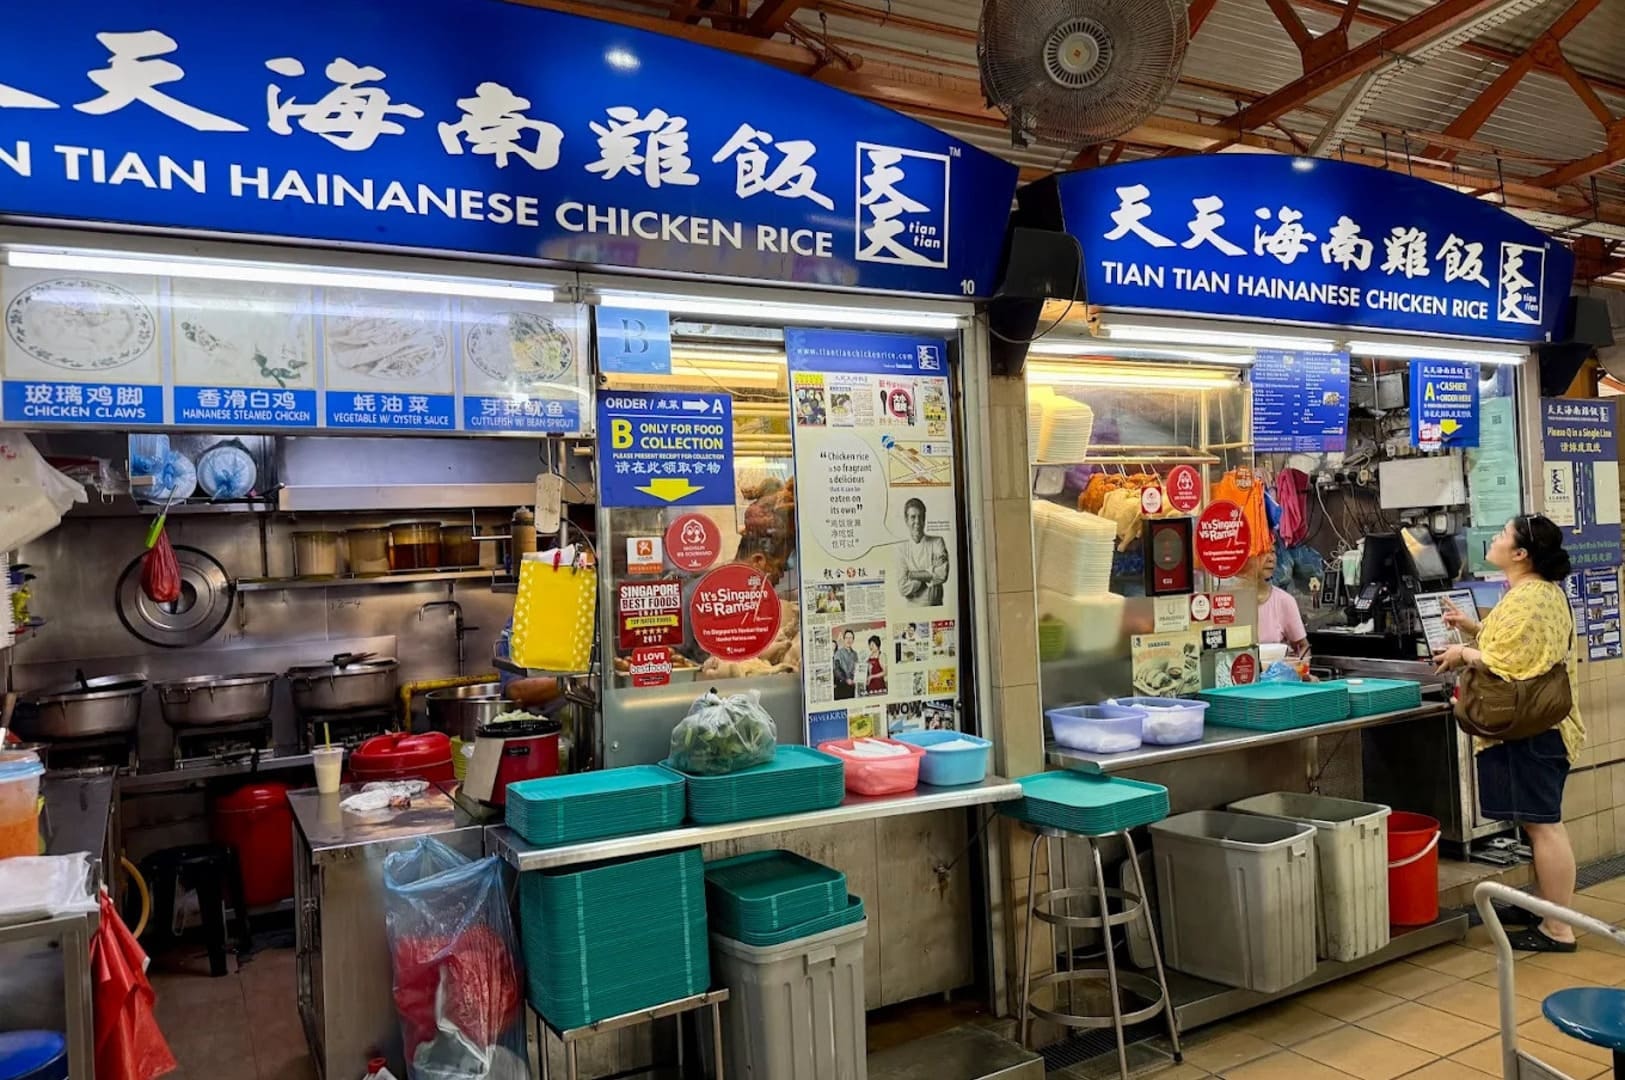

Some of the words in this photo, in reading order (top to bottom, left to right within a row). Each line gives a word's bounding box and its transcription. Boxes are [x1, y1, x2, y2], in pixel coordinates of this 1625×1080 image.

[54, 145, 206, 194] TIAN
[230, 164, 539, 227] HAINANESE
[555, 201, 743, 249] CHICKEN
[757, 224, 833, 257] RICE
[909, 221, 936, 235] tian
[1102, 183, 1491, 287] 天天海南雞飯
[913, 235, 941, 249] tian
[960, 279, 975, 295] 10
[1102, 262, 1165, 289] TIAN
[1173, 267, 1230, 294] TIAN
[1238, 275, 1361, 308] HAINANESE
[1366, 289, 1448, 317] CHICKEN
[1452, 298, 1489, 320] RICE
[622, 319, 650, 354] B
[25, 384, 143, 405] 玻璃鸡脚
[1425, 382, 1435, 401] A
[197, 389, 296, 410] 香滑白鸡
[353, 394, 429, 413] 蚝油菜
[606, 397, 648, 410] ORDER
[712, 399, 724, 414] A
[23, 405, 91, 418] CHICKEN
[97, 406, 146, 418] CLAWS
[183, 409, 232, 420] HAINANESE
[234, 410, 273, 421] STEAMED
[275, 410, 310, 421] CHICKEN
[481, 399, 564, 418] 芽菜鱿鱼
[333, 412, 377, 424] VEGETABLE
[379, 413, 391, 424] W/
[393, 414, 423, 425] OYSTER
[424, 415, 449, 425] SAUCE
[471, 415, 513, 427] CUTTLEFISH
[527, 417, 546, 427] BEAN
[547, 417, 574, 428] SPROUT
[611, 418, 634, 449] B
[640, 423, 669, 434] ONLY
[671, 423, 692, 434] FOR
[694, 424, 724, 435] FOOD
[1547, 427, 1565, 437] Please
[1583, 427, 1599, 439] Single
[1600, 428, 1612, 438] Line
[640, 436, 724, 450] COLLECTION
[615, 461, 721, 474] 请在此领取食物
[842, 463, 872, 474] fragrant
[830, 495, 851, 503] eaten
[852, 495, 862, 503] on
[621, 584, 680, 598] SINGAPORE
[700, 591, 717, 602] It's
[717, 588, 768, 604] Singapore
[622, 599, 647, 609] BEST
[649, 597, 679, 607] FOODS
[713, 601, 760, 616] Ramsay
[643, 635, 663, 644] 2017
[637, 653, 641, 662] I
[643, 652, 665, 661] LOVE
